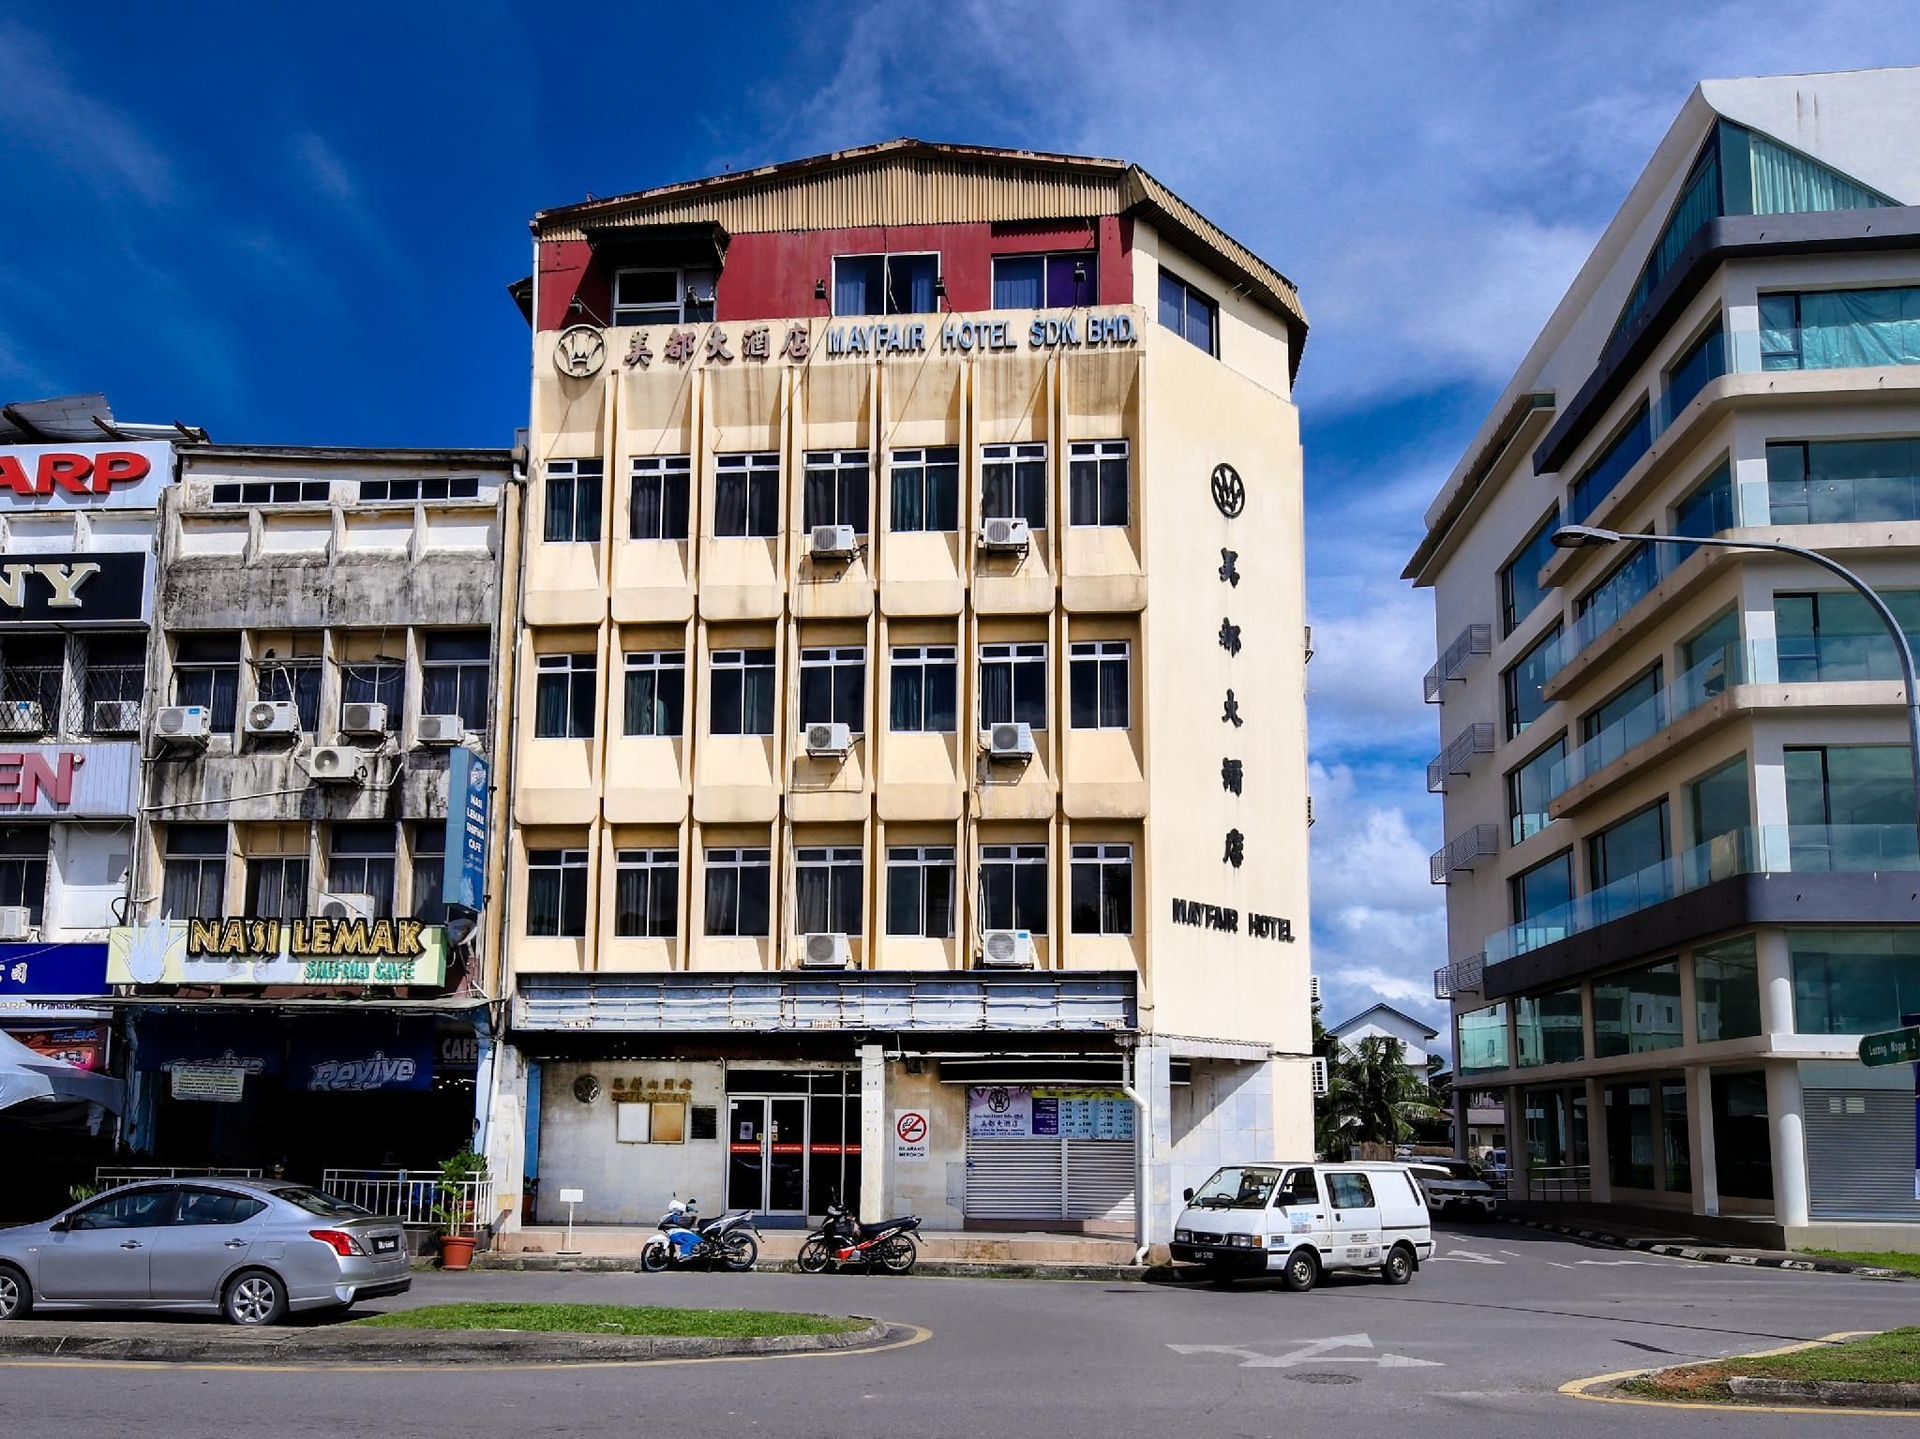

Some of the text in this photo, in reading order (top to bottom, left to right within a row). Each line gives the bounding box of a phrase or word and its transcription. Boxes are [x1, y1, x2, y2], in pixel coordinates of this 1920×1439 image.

[624, 323, 811, 366] 美都大酒店
[826, 313, 1138, 355] MAYFAIR HOTEL SDN. BHD.
[466, 807, 485, 825] LEMAK
[470, 794, 483, 809] NASI
[468, 839, 482, 853] CAFE
[189, 918, 424, 955] NASI LEMAK
[1172, 898, 1295, 943] MAYFAIR HOTEL
[442, 1038, 477, 1060] CAFE
[307, 1051, 416, 1091] Revive
